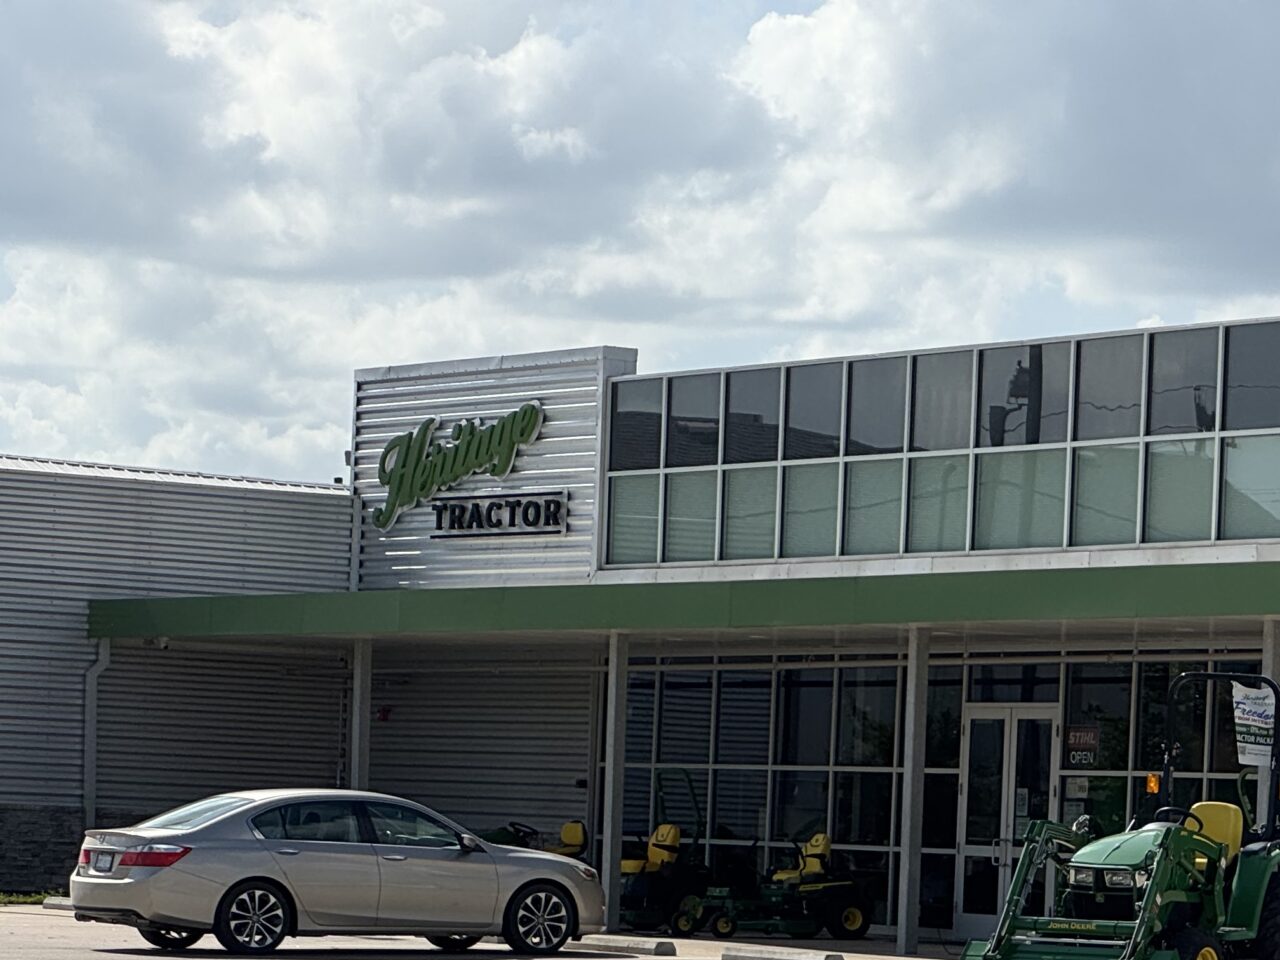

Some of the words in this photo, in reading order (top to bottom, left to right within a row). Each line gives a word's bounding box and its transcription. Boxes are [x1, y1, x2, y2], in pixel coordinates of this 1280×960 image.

[373, 402, 540, 530] Heritage
[431, 500, 562, 530] TRACTOR
[1068, 732, 1096, 744] STIHL
[1070, 751, 1094, 764] OPEN
[1048, 921, 1069, 929] JOHN
[1070, 922, 1097, 930] DEERE
